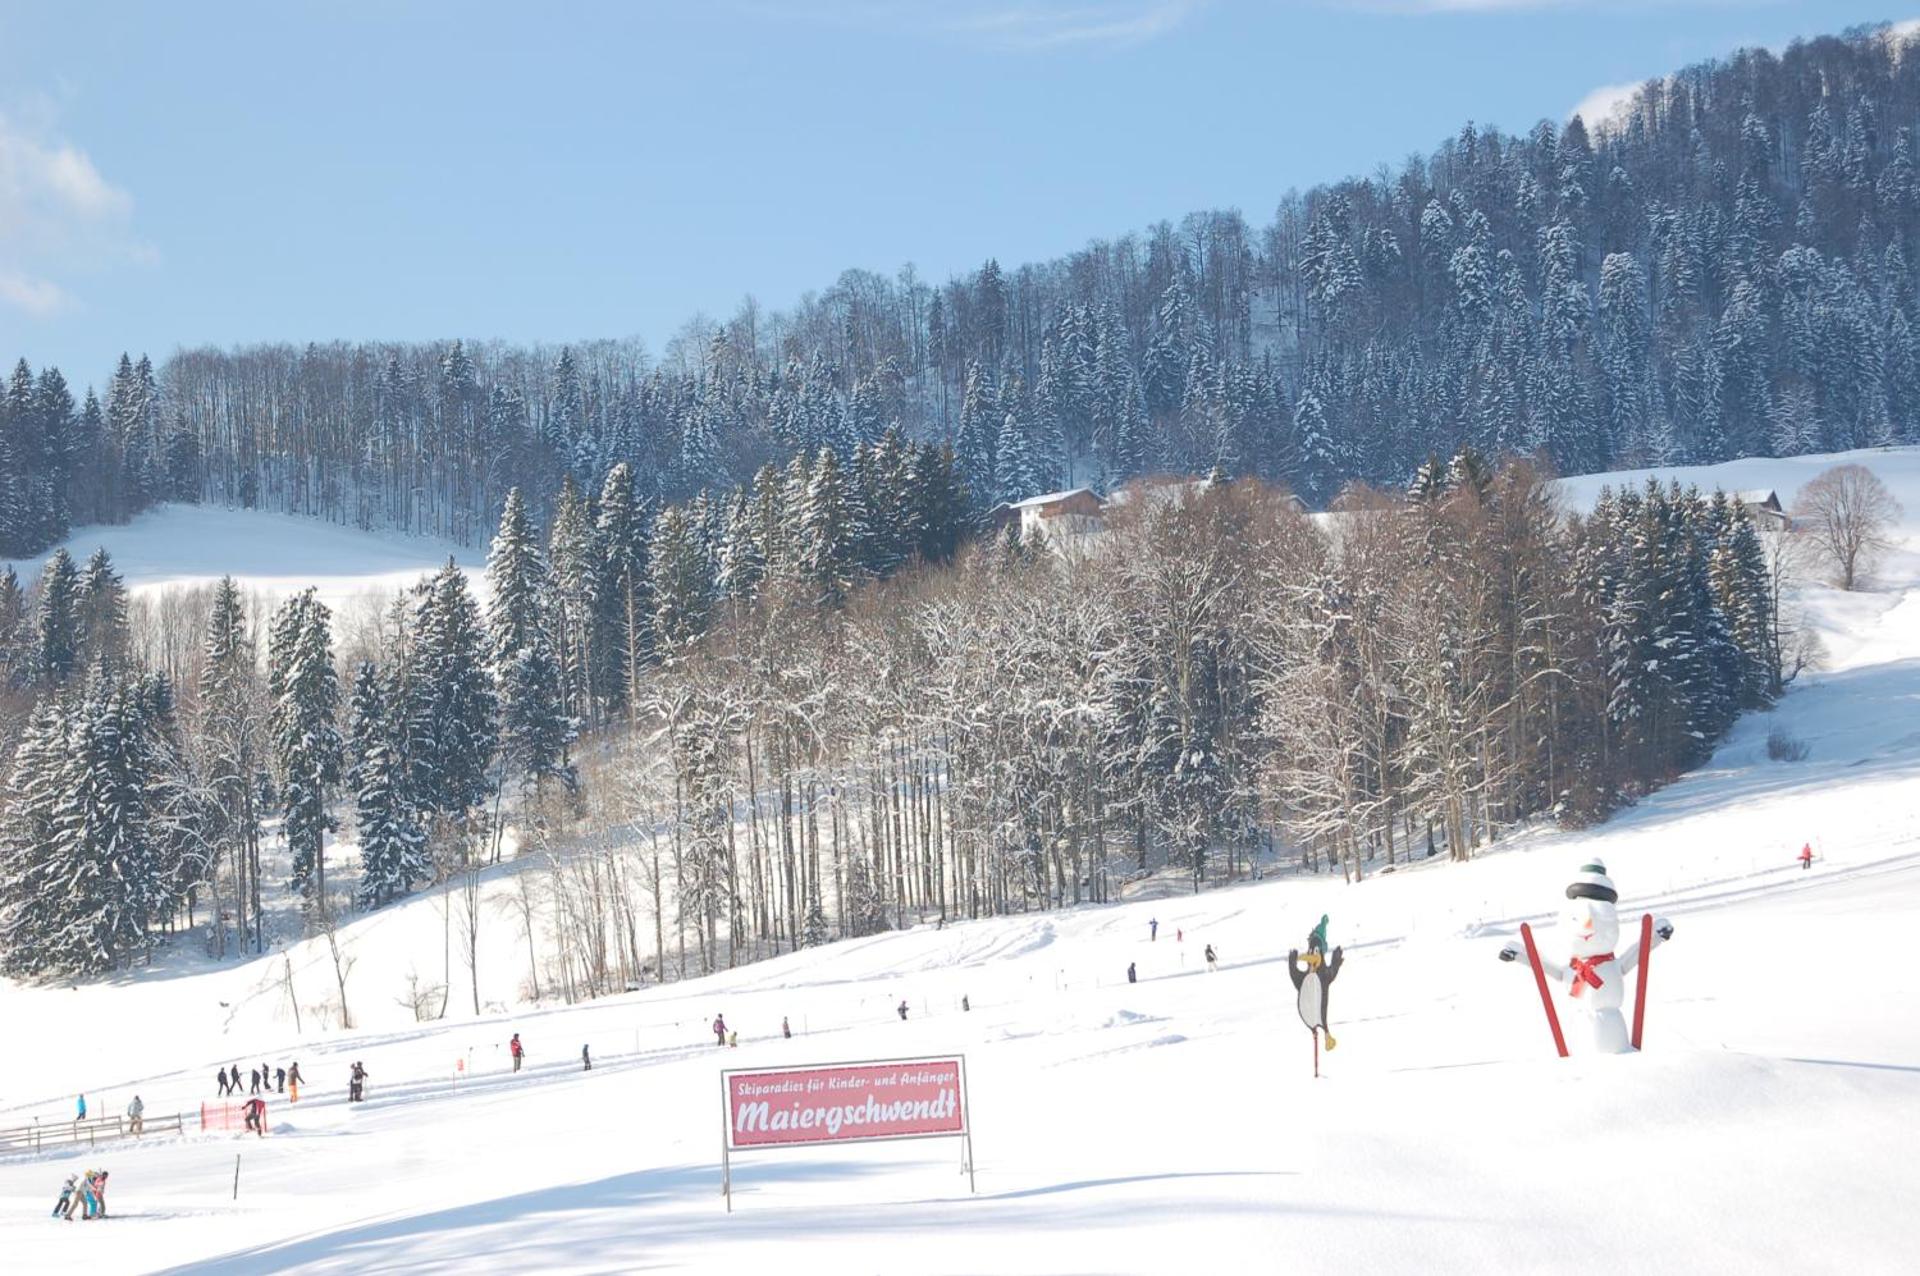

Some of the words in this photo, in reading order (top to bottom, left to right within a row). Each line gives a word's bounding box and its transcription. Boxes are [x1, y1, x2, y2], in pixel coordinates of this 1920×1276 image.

[738, 1077, 803, 1097] Skiparadies
[807, 1077, 825, 1093] für
[828, 1075, 870, 1090] Kinder-
[874, 1073, 897, 1087] und
[900, 1071, 955, 1087] Anfänger
[736, 1089, 957, 1135] Maiergschwendt
